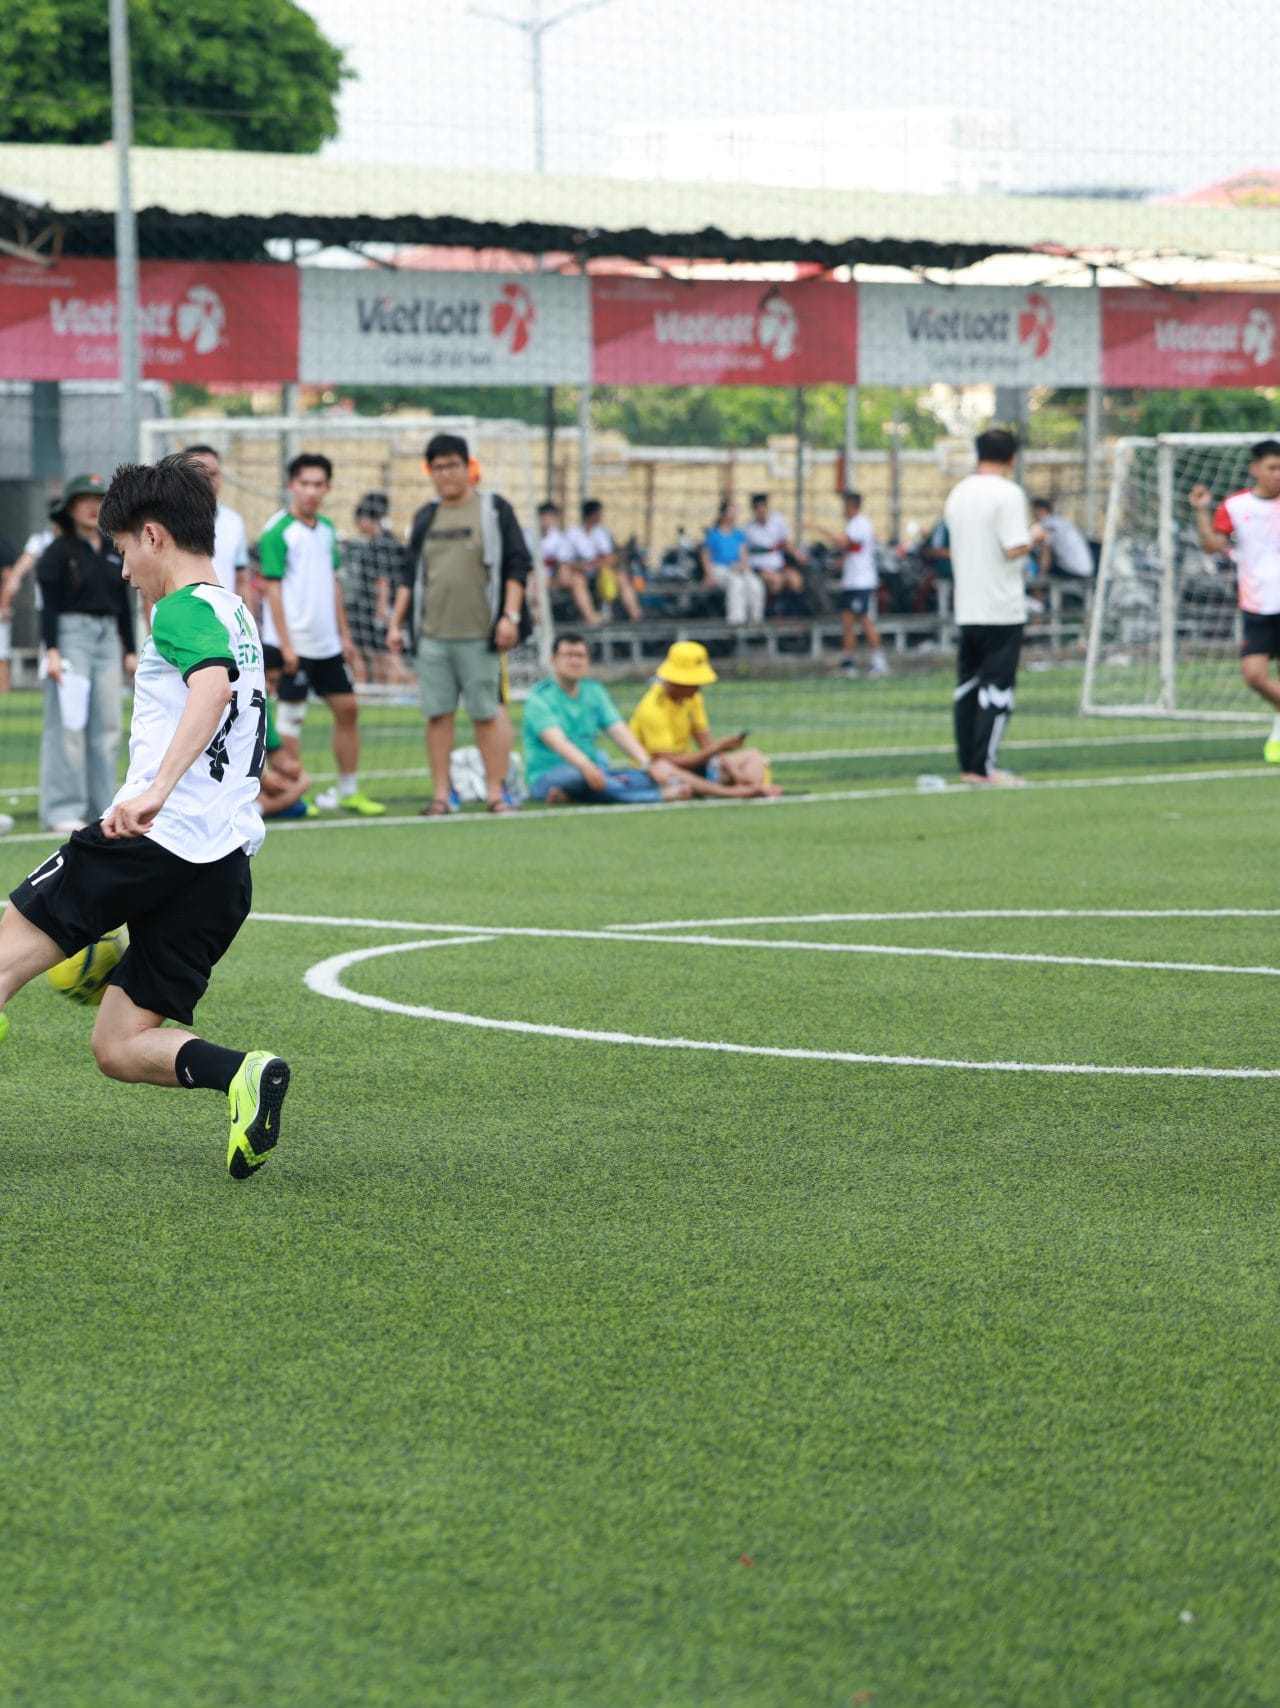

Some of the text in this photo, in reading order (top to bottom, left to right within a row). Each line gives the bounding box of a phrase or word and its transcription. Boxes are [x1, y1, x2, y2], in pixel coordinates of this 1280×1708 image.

[49, 296, 171, 336] Viettt
[356, 297, 481, 335] Vietlott
[906, 306, 1011, 343] Vietlott
